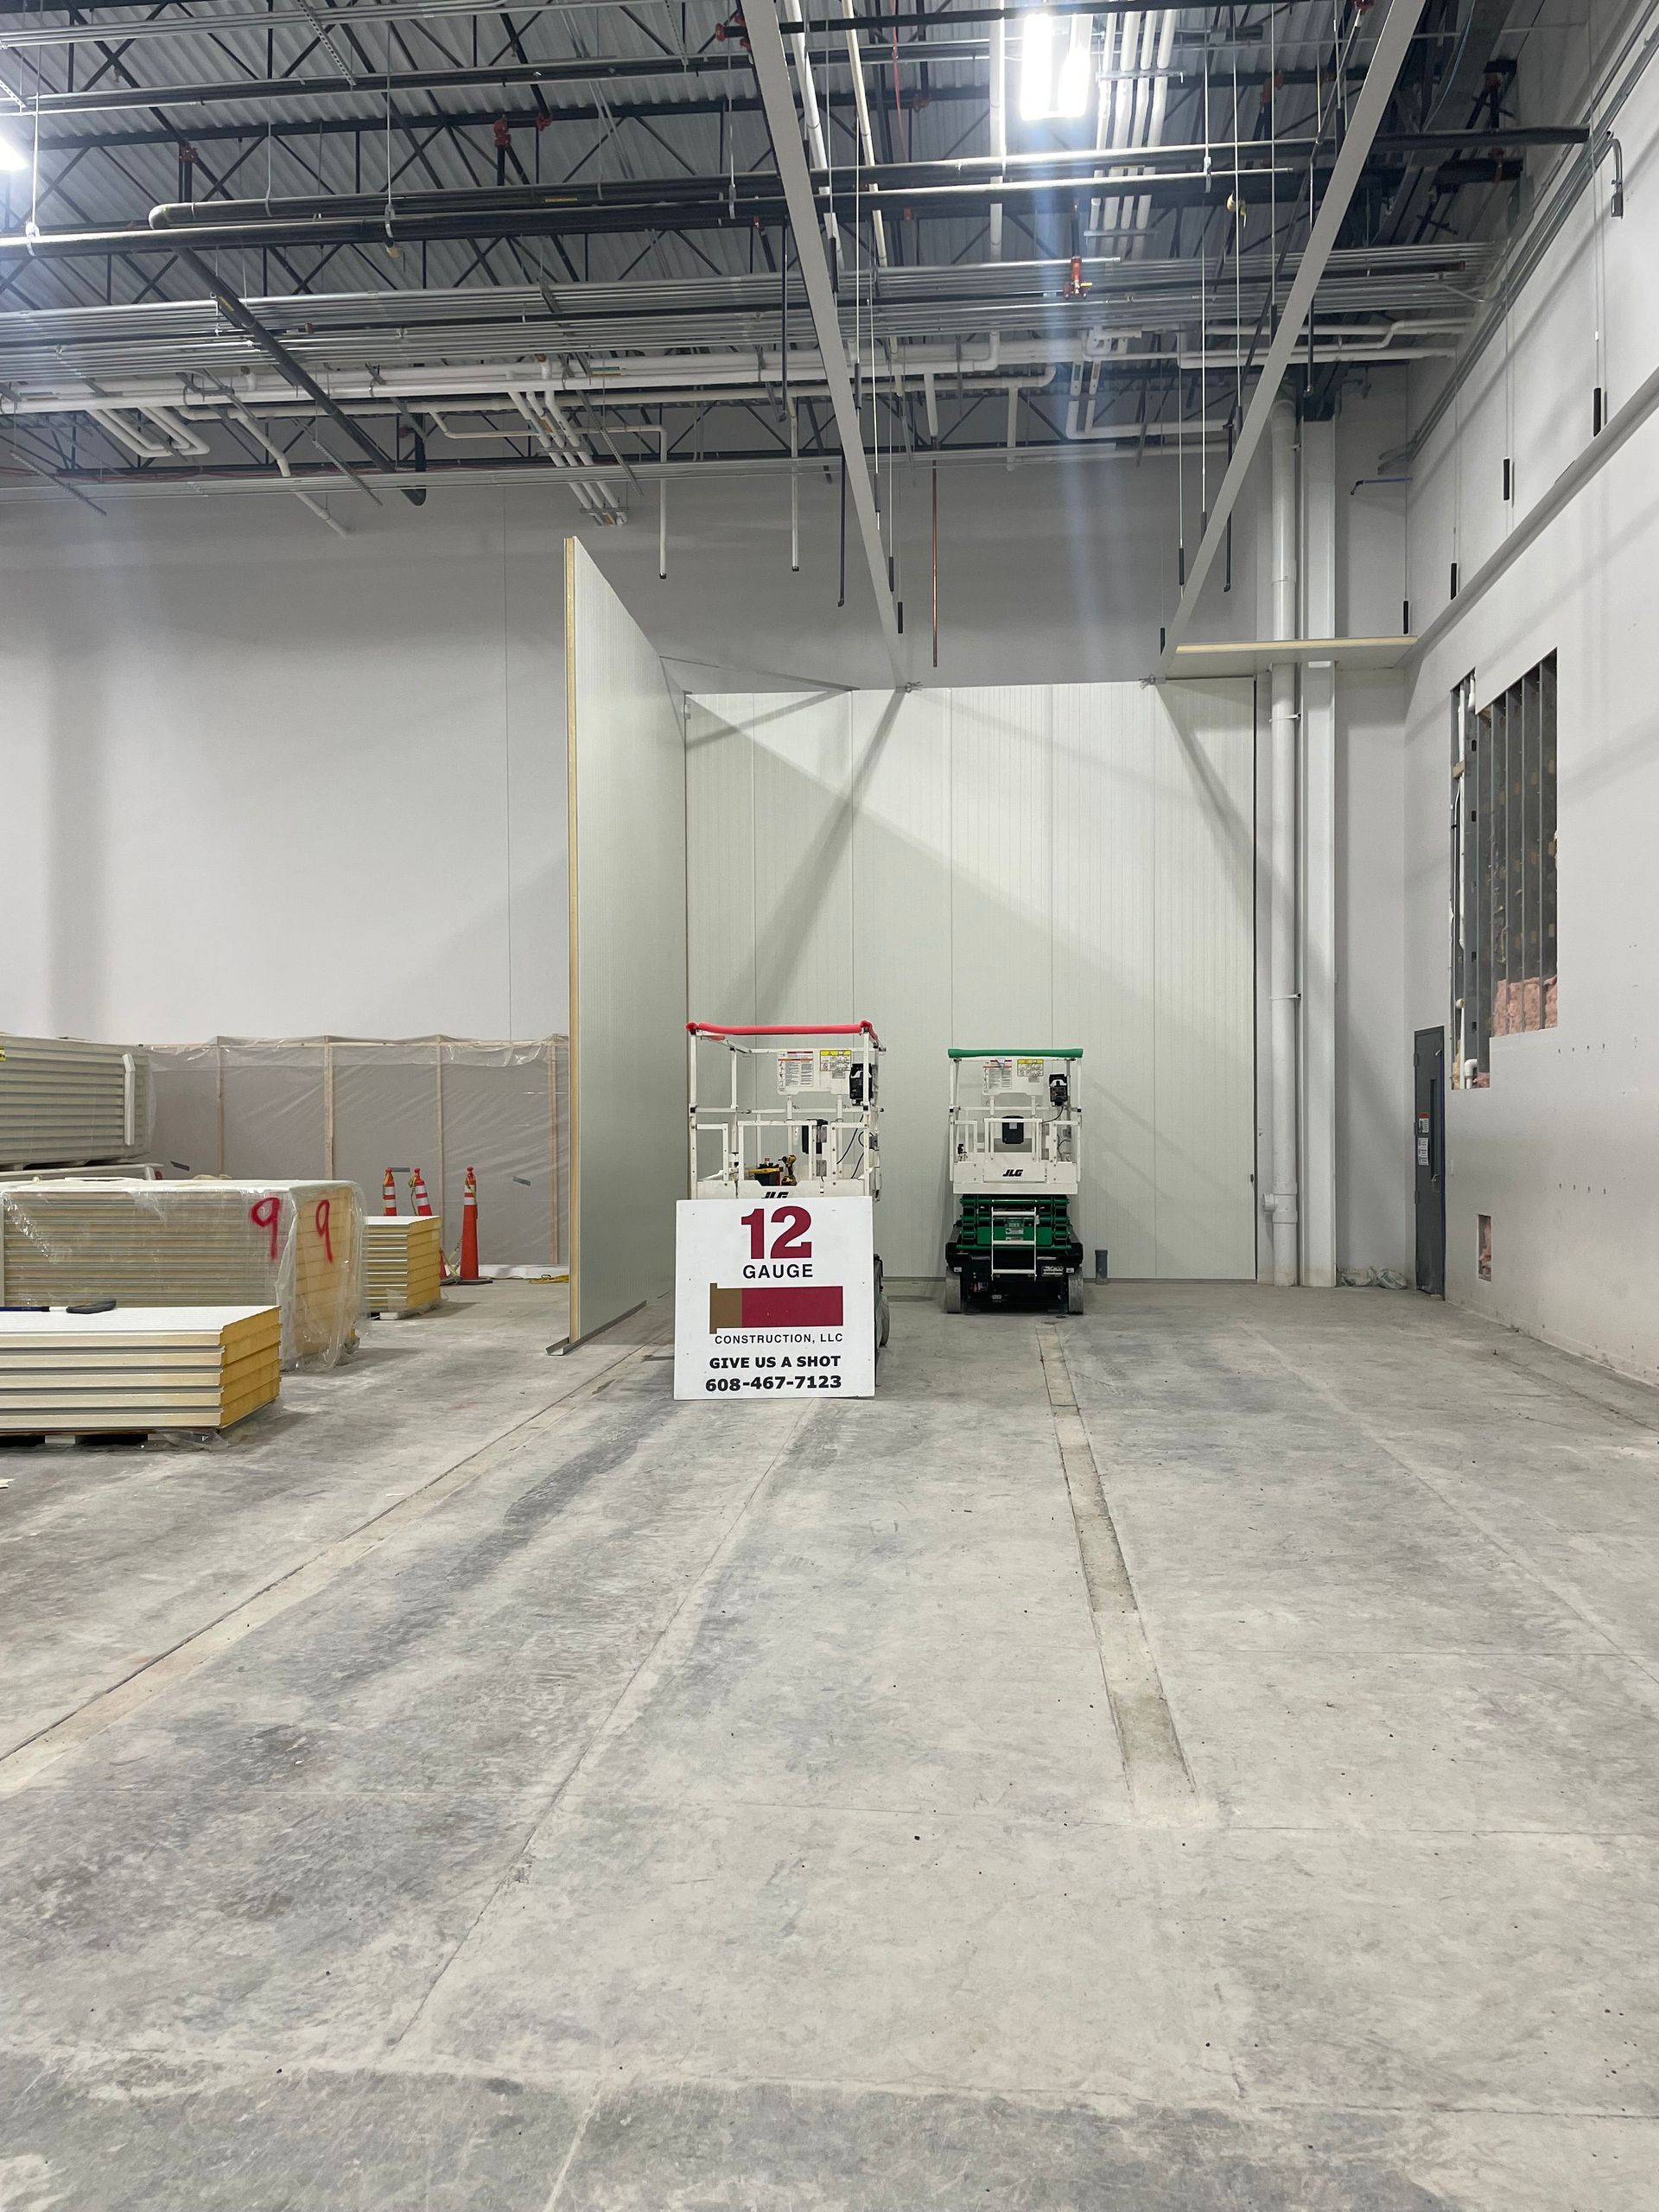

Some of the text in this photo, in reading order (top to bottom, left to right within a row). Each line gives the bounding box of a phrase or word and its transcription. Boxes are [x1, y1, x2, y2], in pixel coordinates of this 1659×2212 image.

[251, 1197, 280, 1260] 9
[315, 1199, 334, 1264] 9
[741, 1205, 812, 1260] 12
[742, 1263, 813, 1280] GAUGE
[714, 1332, 843, 1345] CONSTRUCTION, LLC
[709, 1355, 842, 1370] GIVE US A SHOT
[705, 1375, 842, 1393] 608-467-7123
